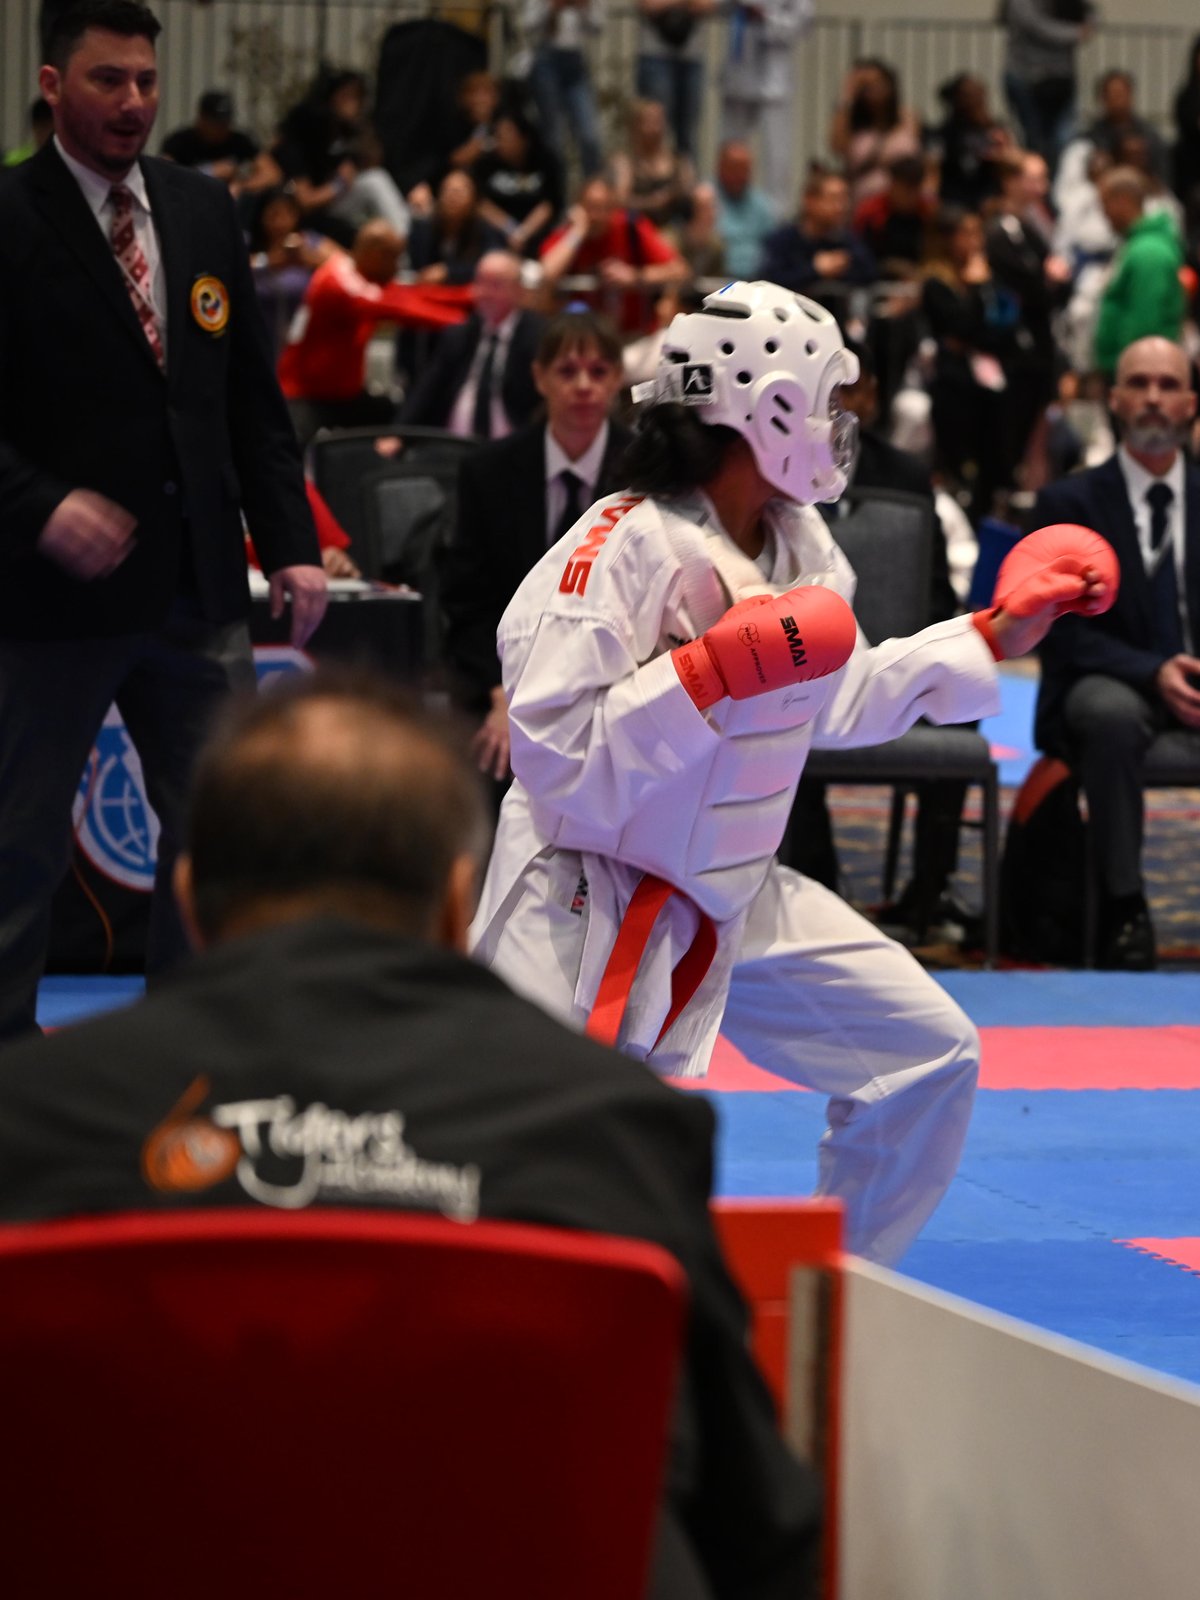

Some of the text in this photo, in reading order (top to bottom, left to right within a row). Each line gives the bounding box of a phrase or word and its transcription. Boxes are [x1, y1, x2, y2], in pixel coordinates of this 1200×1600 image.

[780, 616, 807, 667] SMAI
[679, 653, 708, 699] SMAI
[570, 869, 589, 917] MAI
